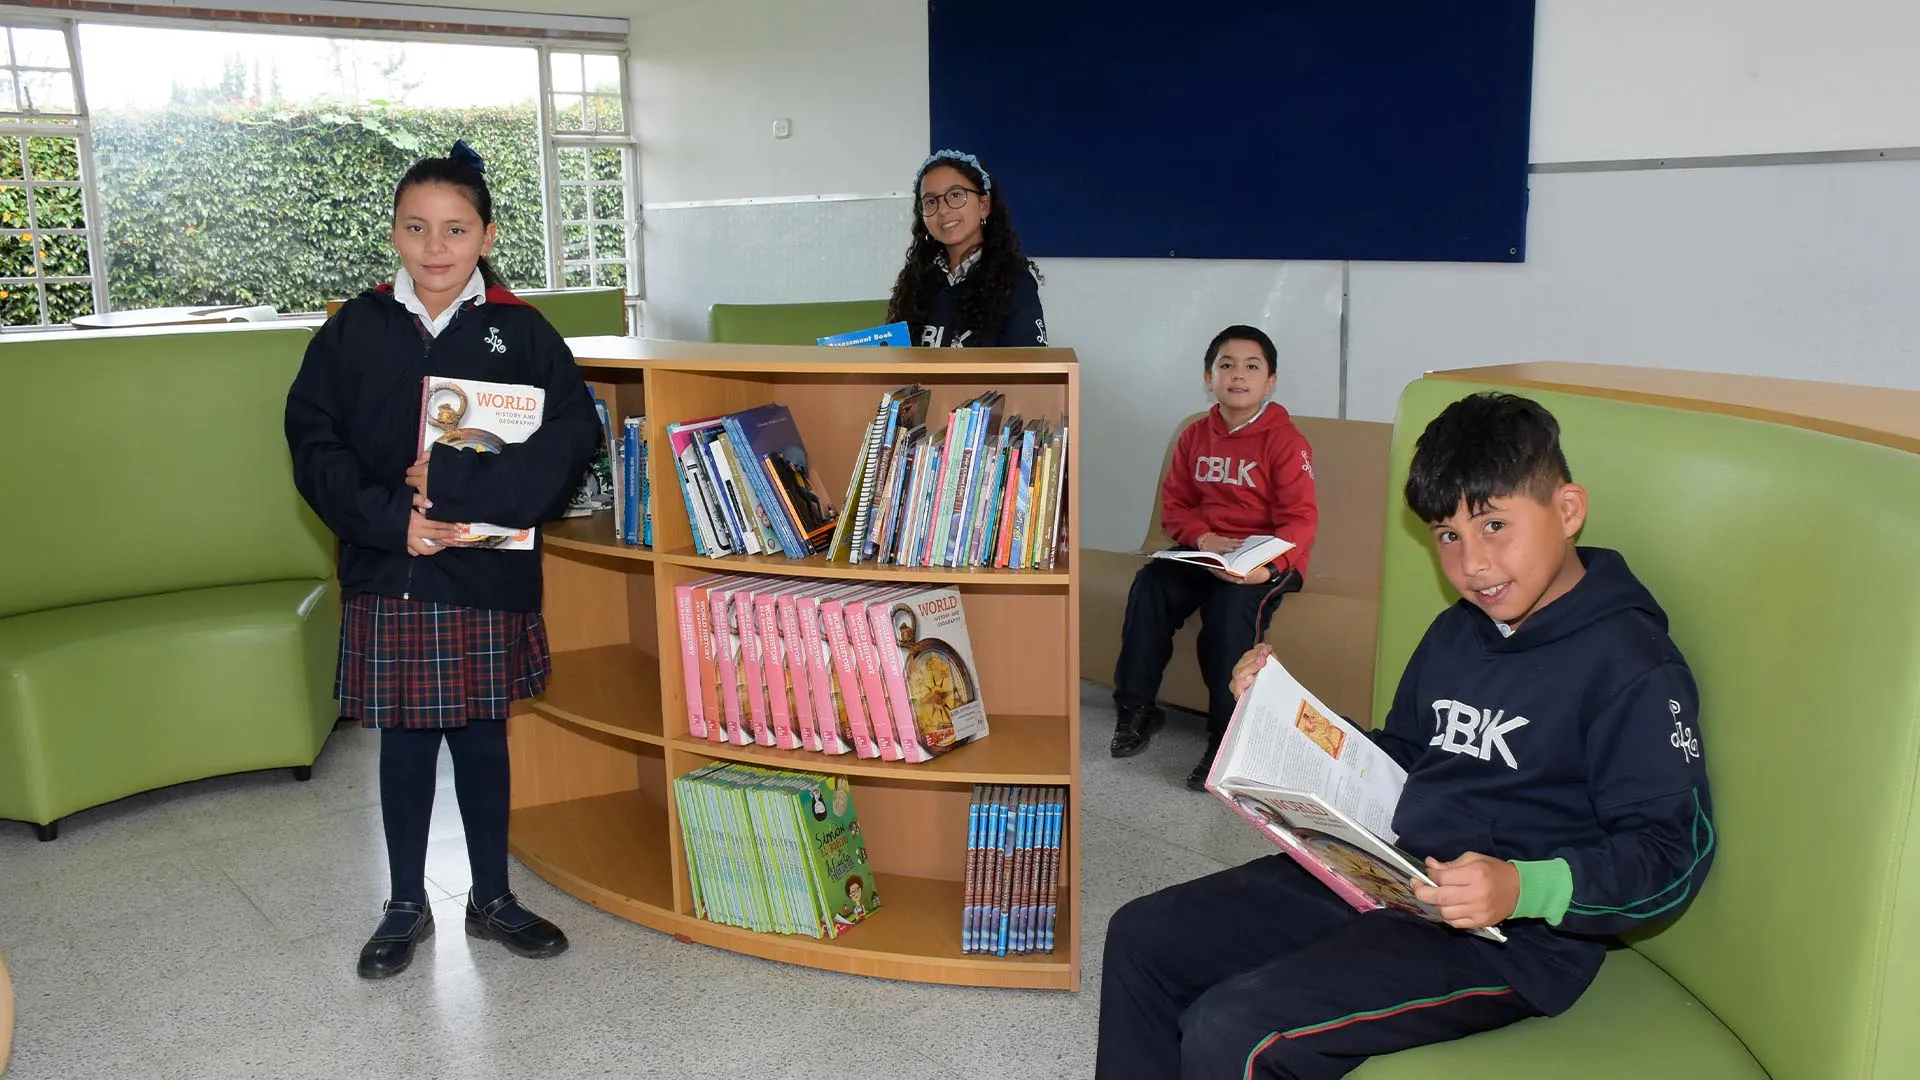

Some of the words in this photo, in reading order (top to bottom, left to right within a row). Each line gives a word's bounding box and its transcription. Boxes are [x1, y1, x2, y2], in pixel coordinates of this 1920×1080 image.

[874, 331, 893, 341] Book
[476, 392, 537, 411] WORLD
[495, 411, 521, 419] HISTORY
[499, 418, 535, 427] GEOGRAPHY
[1195, 456, 1258, 488] CBLK
[683, 595, 691, 623] WORLD
[699, 600, 707, 628] WORLD
[717, 601, 725, 628] WORLD
[743, 601, 752, 629] WORLD
[764, 604, 773, 632] WORLD
[917, 594, 957, 617] WORLD
[786, 605, 796, 633] WORLD
[791, 633, 801, 666] HISTORY
[806, 607, 817, 636] WORLD
[686, 623, 694, 656] HISTORY
[702, 628, 710, 660] HISTORY
[720, 629, 729, 661] HISTORY
[746, 630, 755, 663] HISTORY
[768, 632, 778, 665] HISTORY
[811, 636, 822, 669] HISTORY
[832, 611, 843, 640] WORLD
[838, 640, 850, 673] HISTORY
[855, 612, 867, 640] WORLD
[862, 641, 875, 675] HISTORY
[879, 613, 890, 643] WORLD
[886, 643, 898, 676] HISTORY
[1265, 797, 1329, 817] WORLD
